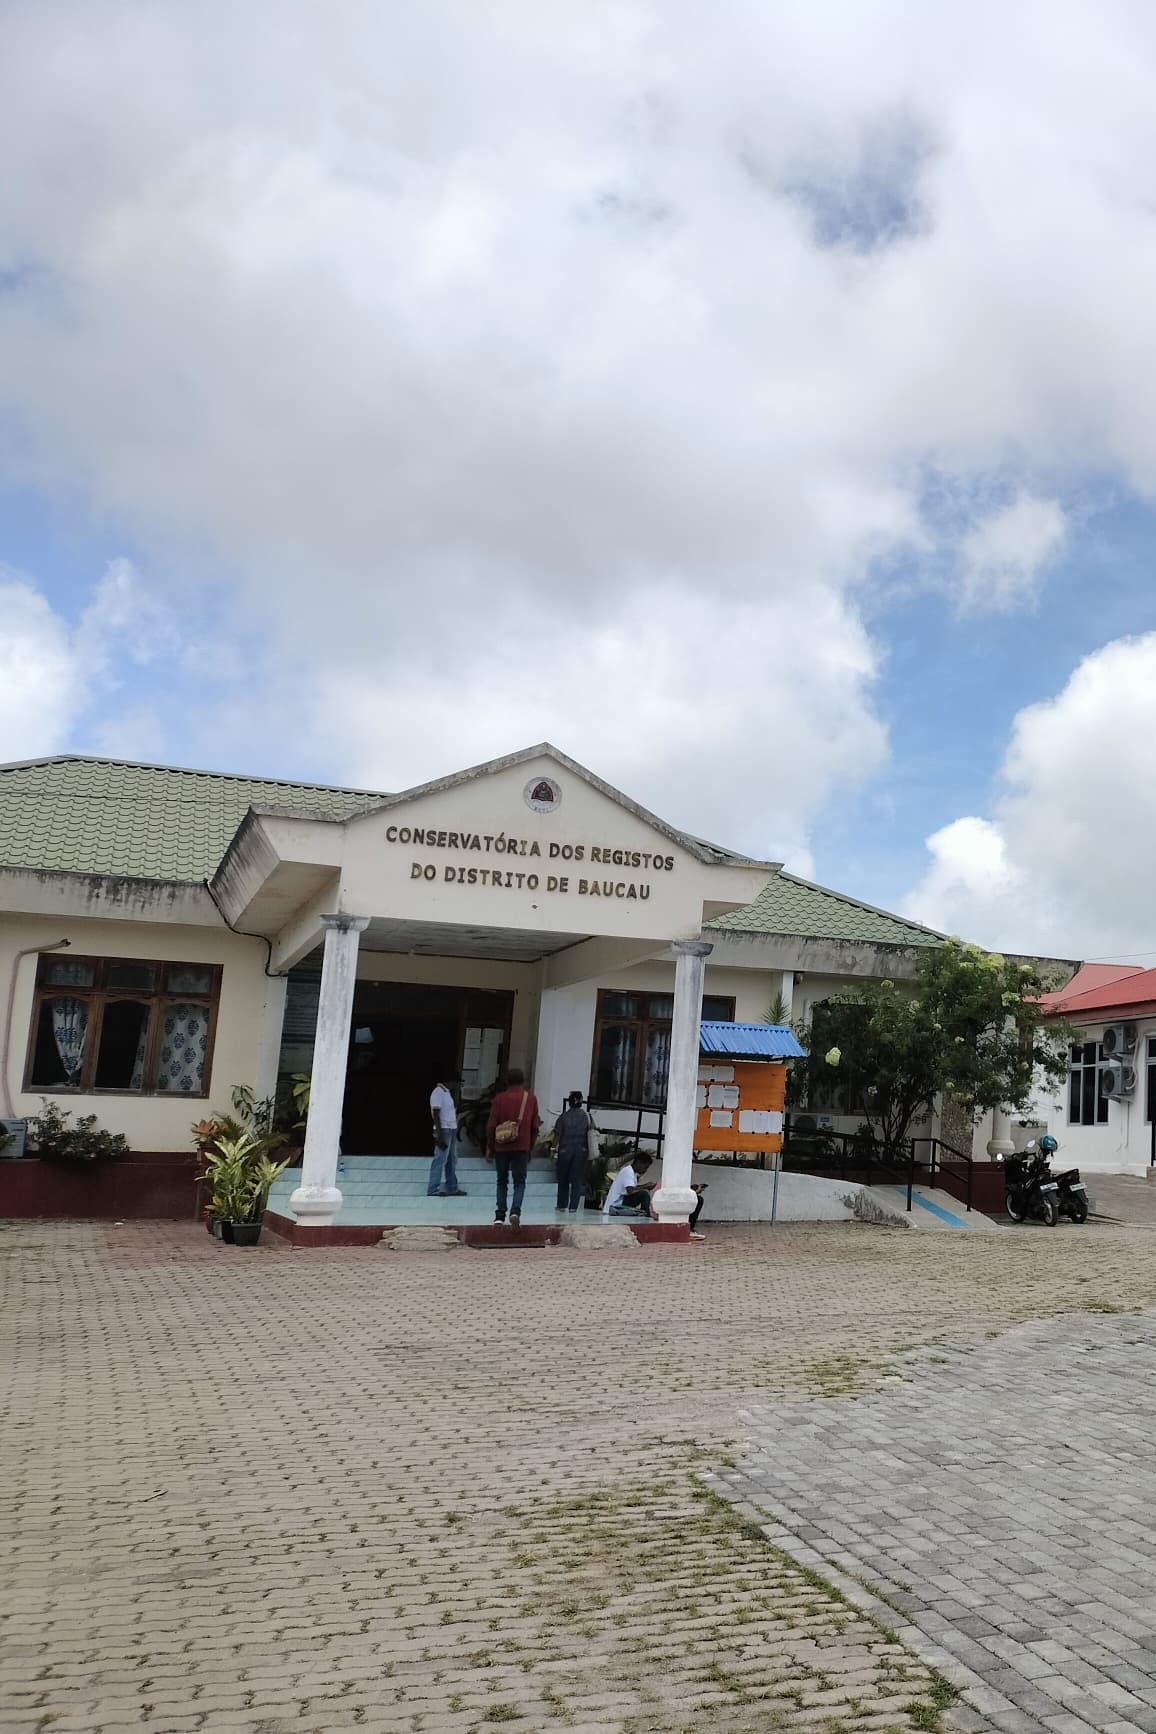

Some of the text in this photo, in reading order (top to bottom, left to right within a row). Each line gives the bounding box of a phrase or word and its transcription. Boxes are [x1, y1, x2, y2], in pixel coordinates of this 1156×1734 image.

[386, 826, 674, 871] CONSERVATÓRIA DOS REGISTOS
[410, 862, 650, 900] DO DISTRITO DE BAUCAU
